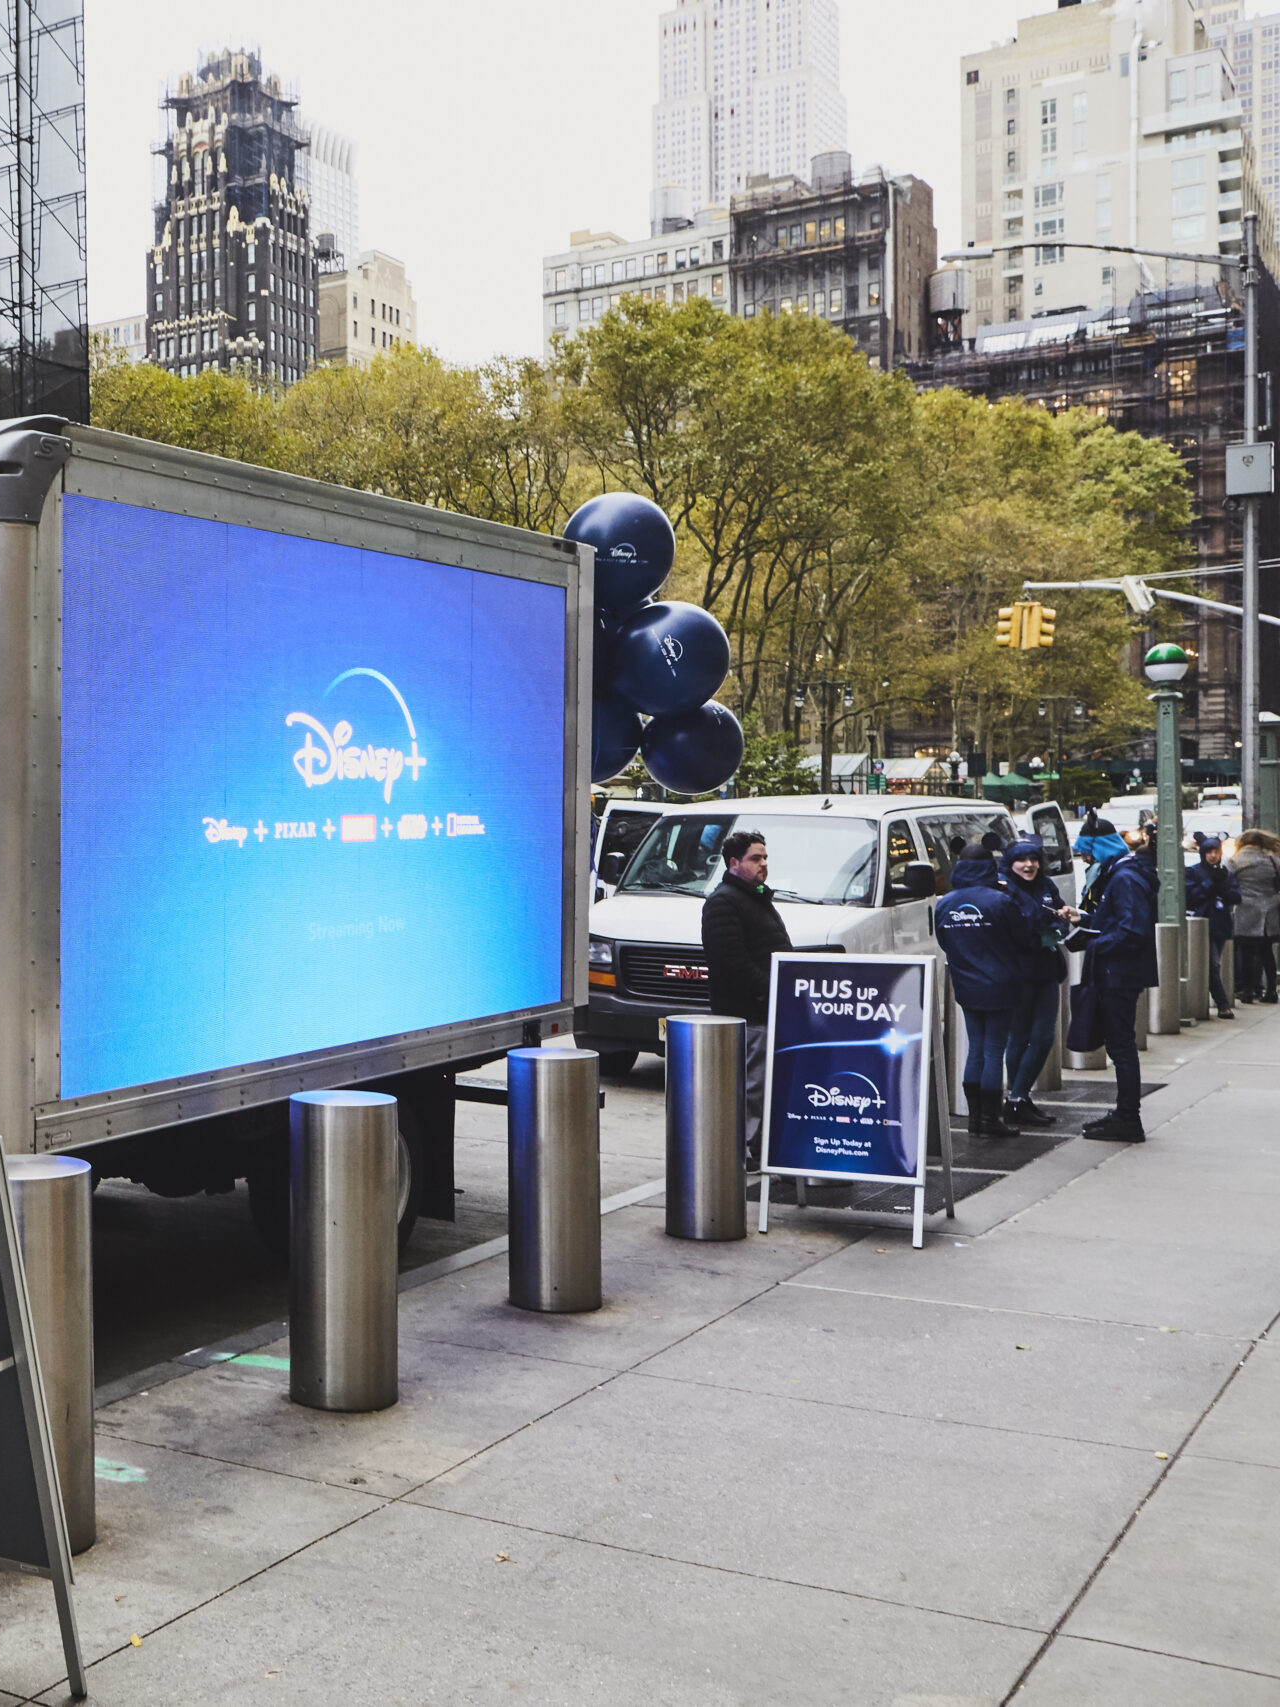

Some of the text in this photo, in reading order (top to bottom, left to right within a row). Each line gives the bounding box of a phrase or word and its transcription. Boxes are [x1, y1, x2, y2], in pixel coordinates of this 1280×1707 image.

[285, 712, 427, 804] Disney+
[202, 817, 248, 848] Disney
[274, 821, 316, 838] PIXAR
[308, 915, 405, 941] Streaming Now
[664, 964, 709, 980] GMC
[794, 979, 878, 1000] PLUS UP
[812, 1002, 906, 1022] YOUR DAY
[805, 1084, 886, 1115] Disney+
[814, 1137, 829, 1147] Sign
[830, 1138, 840, 1147] Up
[842, 1139, 862, 1148] Today
[815, 1146, 869, 1157] DisneyPlus.com
